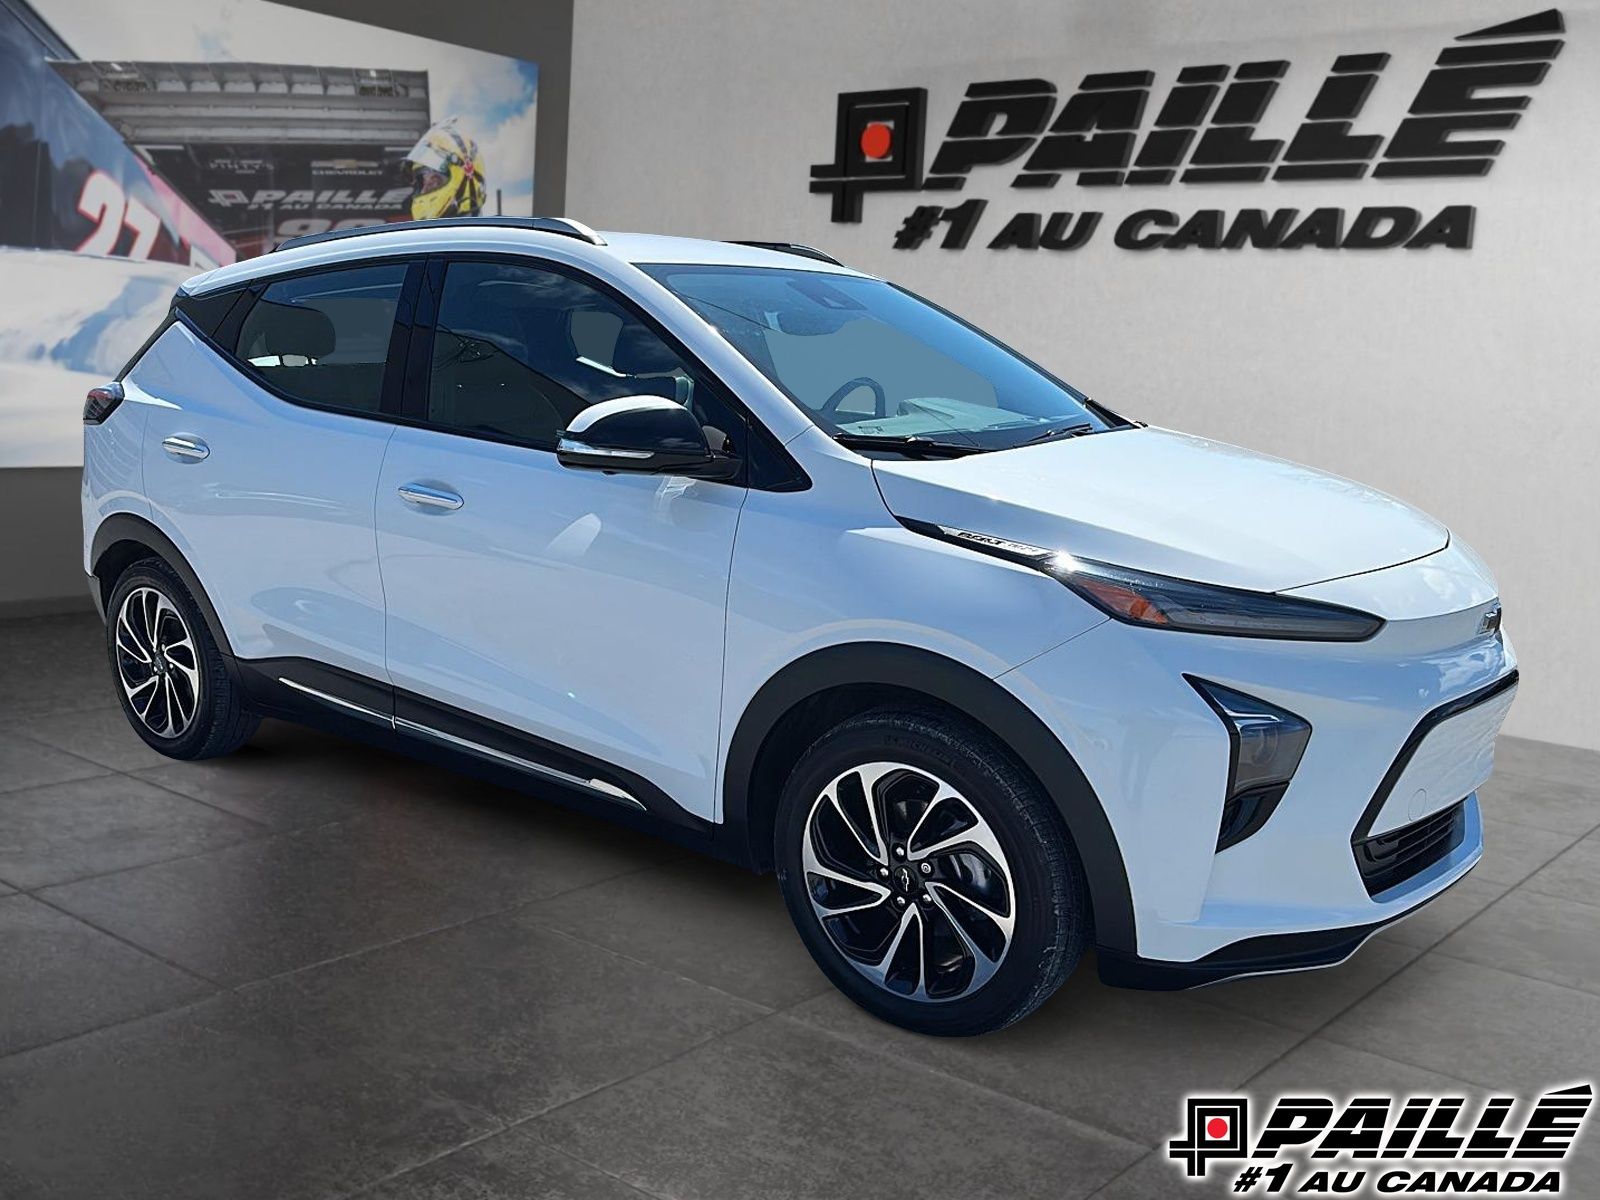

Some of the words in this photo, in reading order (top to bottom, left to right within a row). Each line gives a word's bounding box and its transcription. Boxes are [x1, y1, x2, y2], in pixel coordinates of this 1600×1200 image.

[922, 9, 1566, 190] PAILLÉ
[893, 199, 988, 251] #1
[987, 211, 1103, 251] AU
[1114, 205, 1476, 251] CANADA
